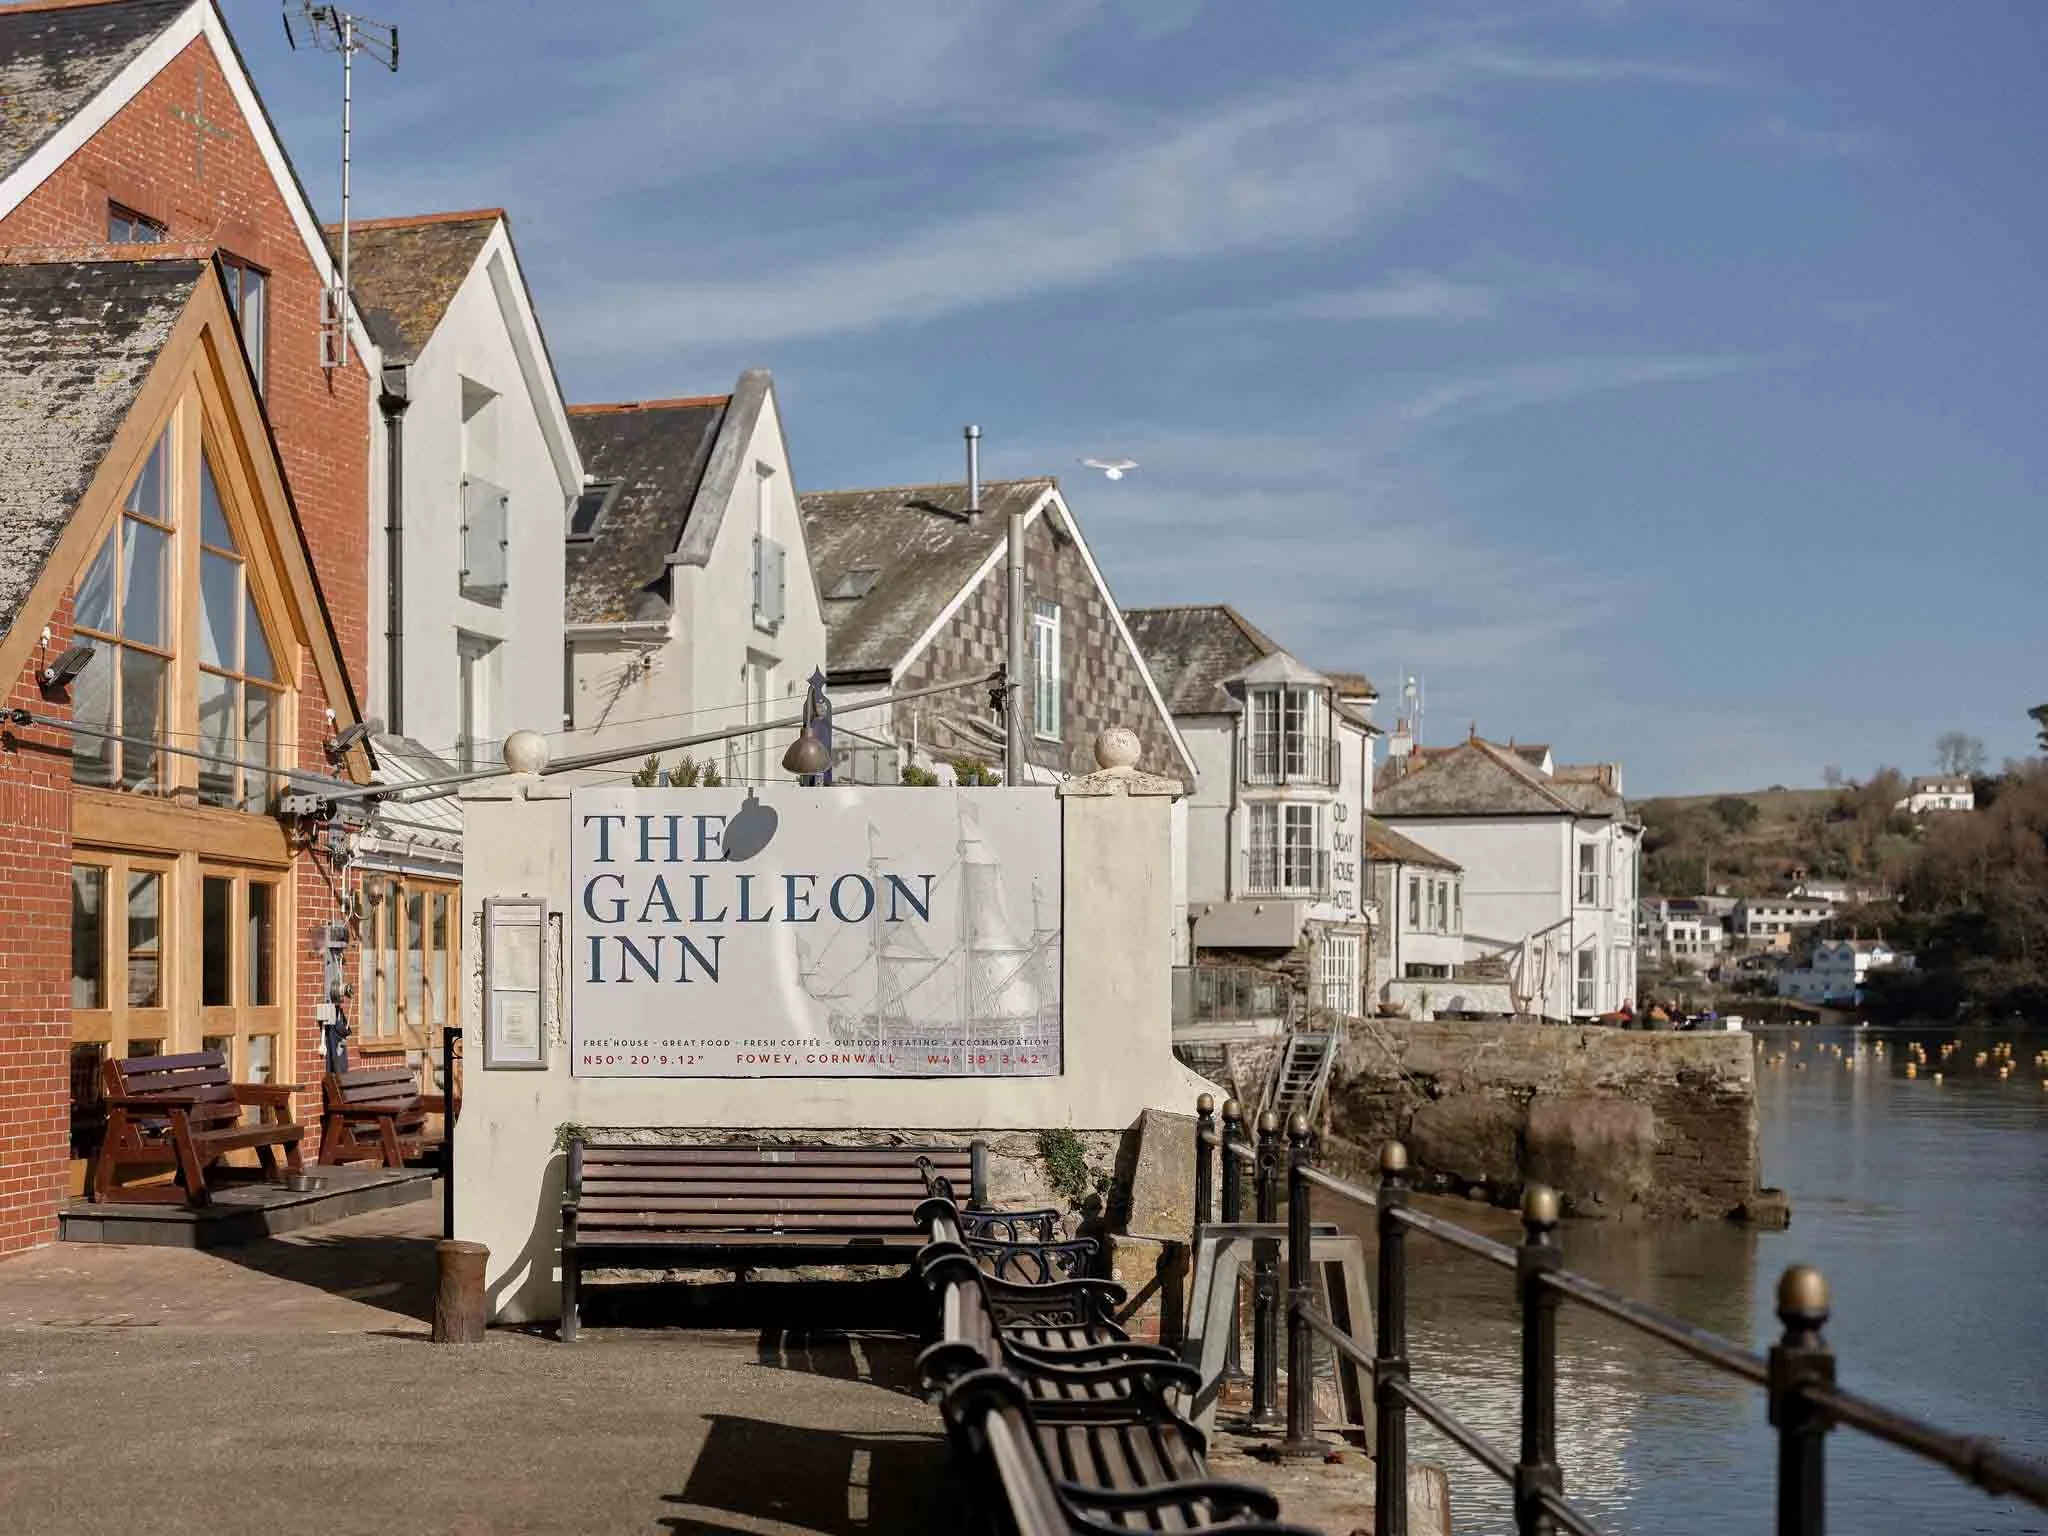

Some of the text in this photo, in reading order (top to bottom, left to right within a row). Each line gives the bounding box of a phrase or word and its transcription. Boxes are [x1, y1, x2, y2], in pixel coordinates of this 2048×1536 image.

[1333, 802, 1347, 822] OLD
[583, 815, 730, 863] THE
[1333, 831, 1354, 853] QUAY
[1333, 860, 1354, 882] HOUSE
[583, 873, 937, 924] GALLEON
[1333, 889, 1352, 910] HOTEL
[584, 935, 726, 984] INN
[583, 1039, 1050, 1047] FREE HOUSE GREAT FOOD FRESH COFFEE OUTDOOR SEATING ACCOMMODATION
[736, 1053, 895, 1065] FOWEY, CORNWALL
